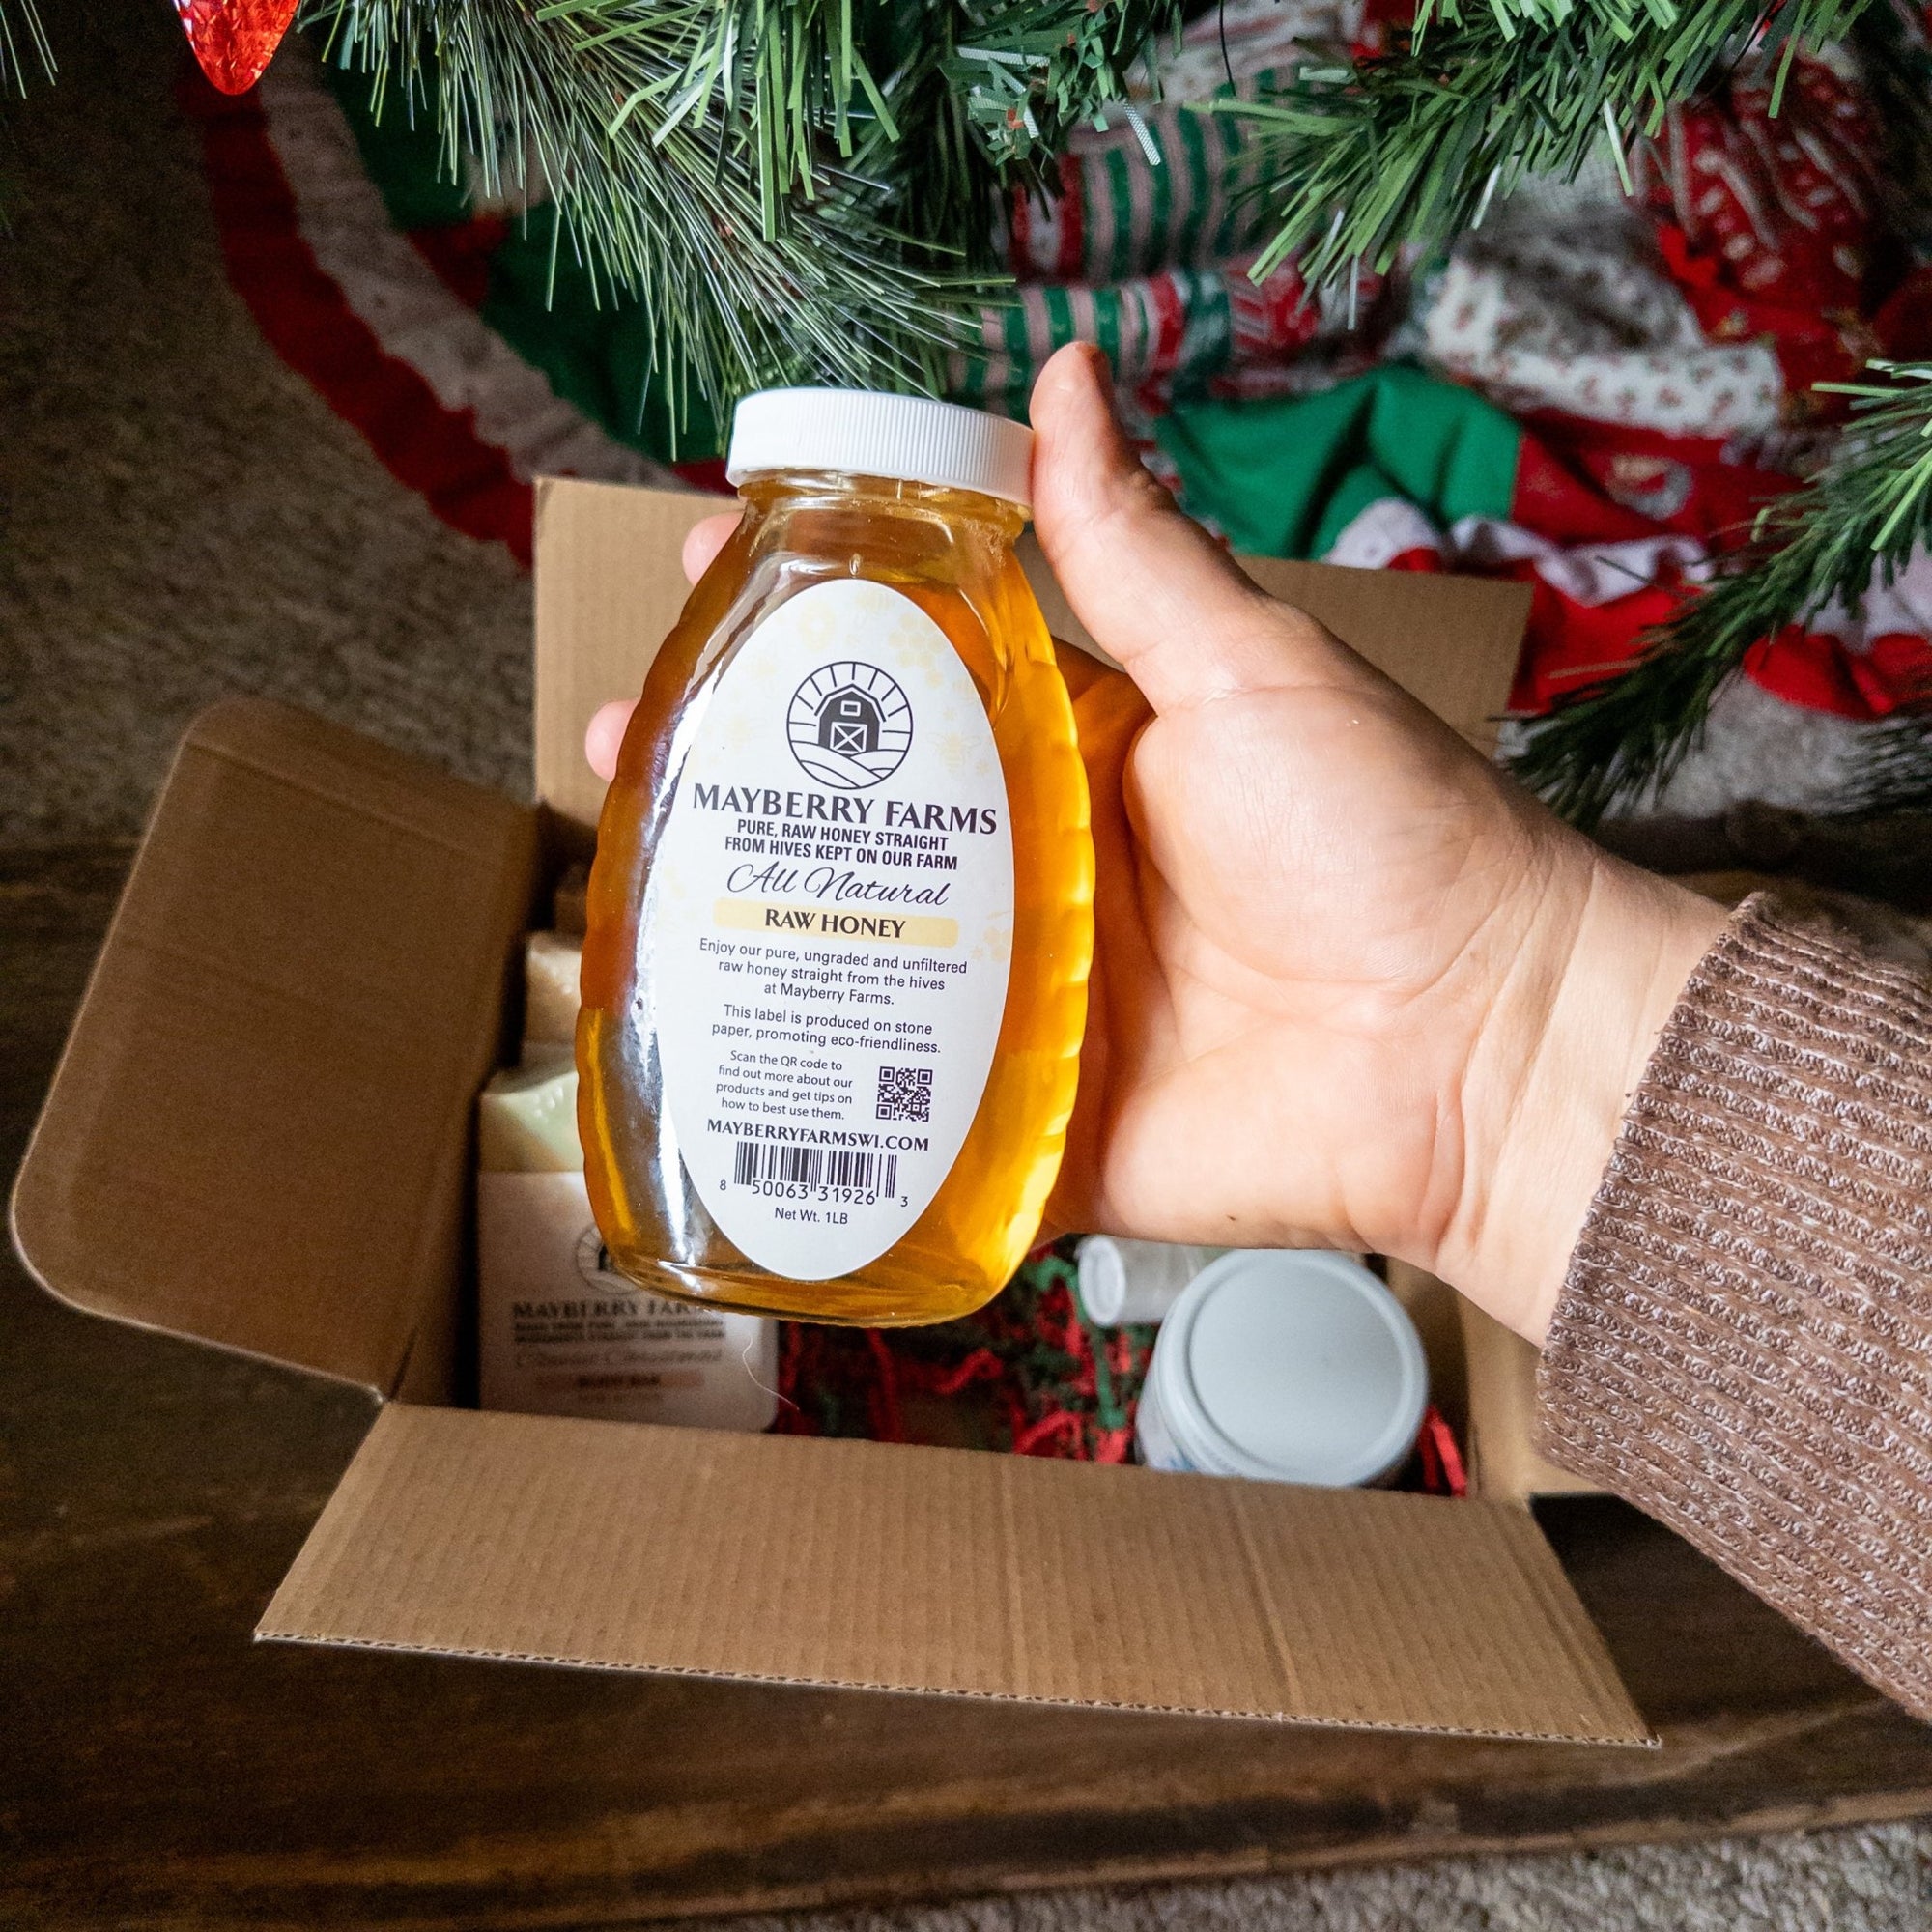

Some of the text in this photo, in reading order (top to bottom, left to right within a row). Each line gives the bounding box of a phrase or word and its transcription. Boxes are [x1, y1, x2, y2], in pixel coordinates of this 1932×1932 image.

[694, 783, 996, 835] MAYBERRY FARMS
[737, 819, 949, 851] PURE, RAW HONEY STRAIGHT
[725, 836, 957, 870] FROM HIVES KEPT ON OUR FARM
[727, 861, 951, 905] All Natural
[765, 908, 906, 938] RAW HONEY
[700, 938, 967, 974] Enjoy our pure, ungraded and unfiltered
[719, 961, 945, 990] raw honey straight from the hives
[764, 982, 894, 1005] at Mayberry Farms.
[724, 1004, 932, 1035] This label is produced on stone
[712, 1024, 940, 1053] paper, promoting eco-friendliness.
[730, 1050, 842, 1071] Scan the QR code to
[719, 1065, 853, 1088] find out more about our
[716, 1083, 852, 1104] products and get tips on
[722, 1097, 844, 1120] how to best use them.
[707, 1118, 928, 1151] MAYBERRYFARMSWI.COM
[720, 1179, 908, 1207] 8 50063 31926 3
[775, 1207, 848, 1224] Net Wt. 1LB
